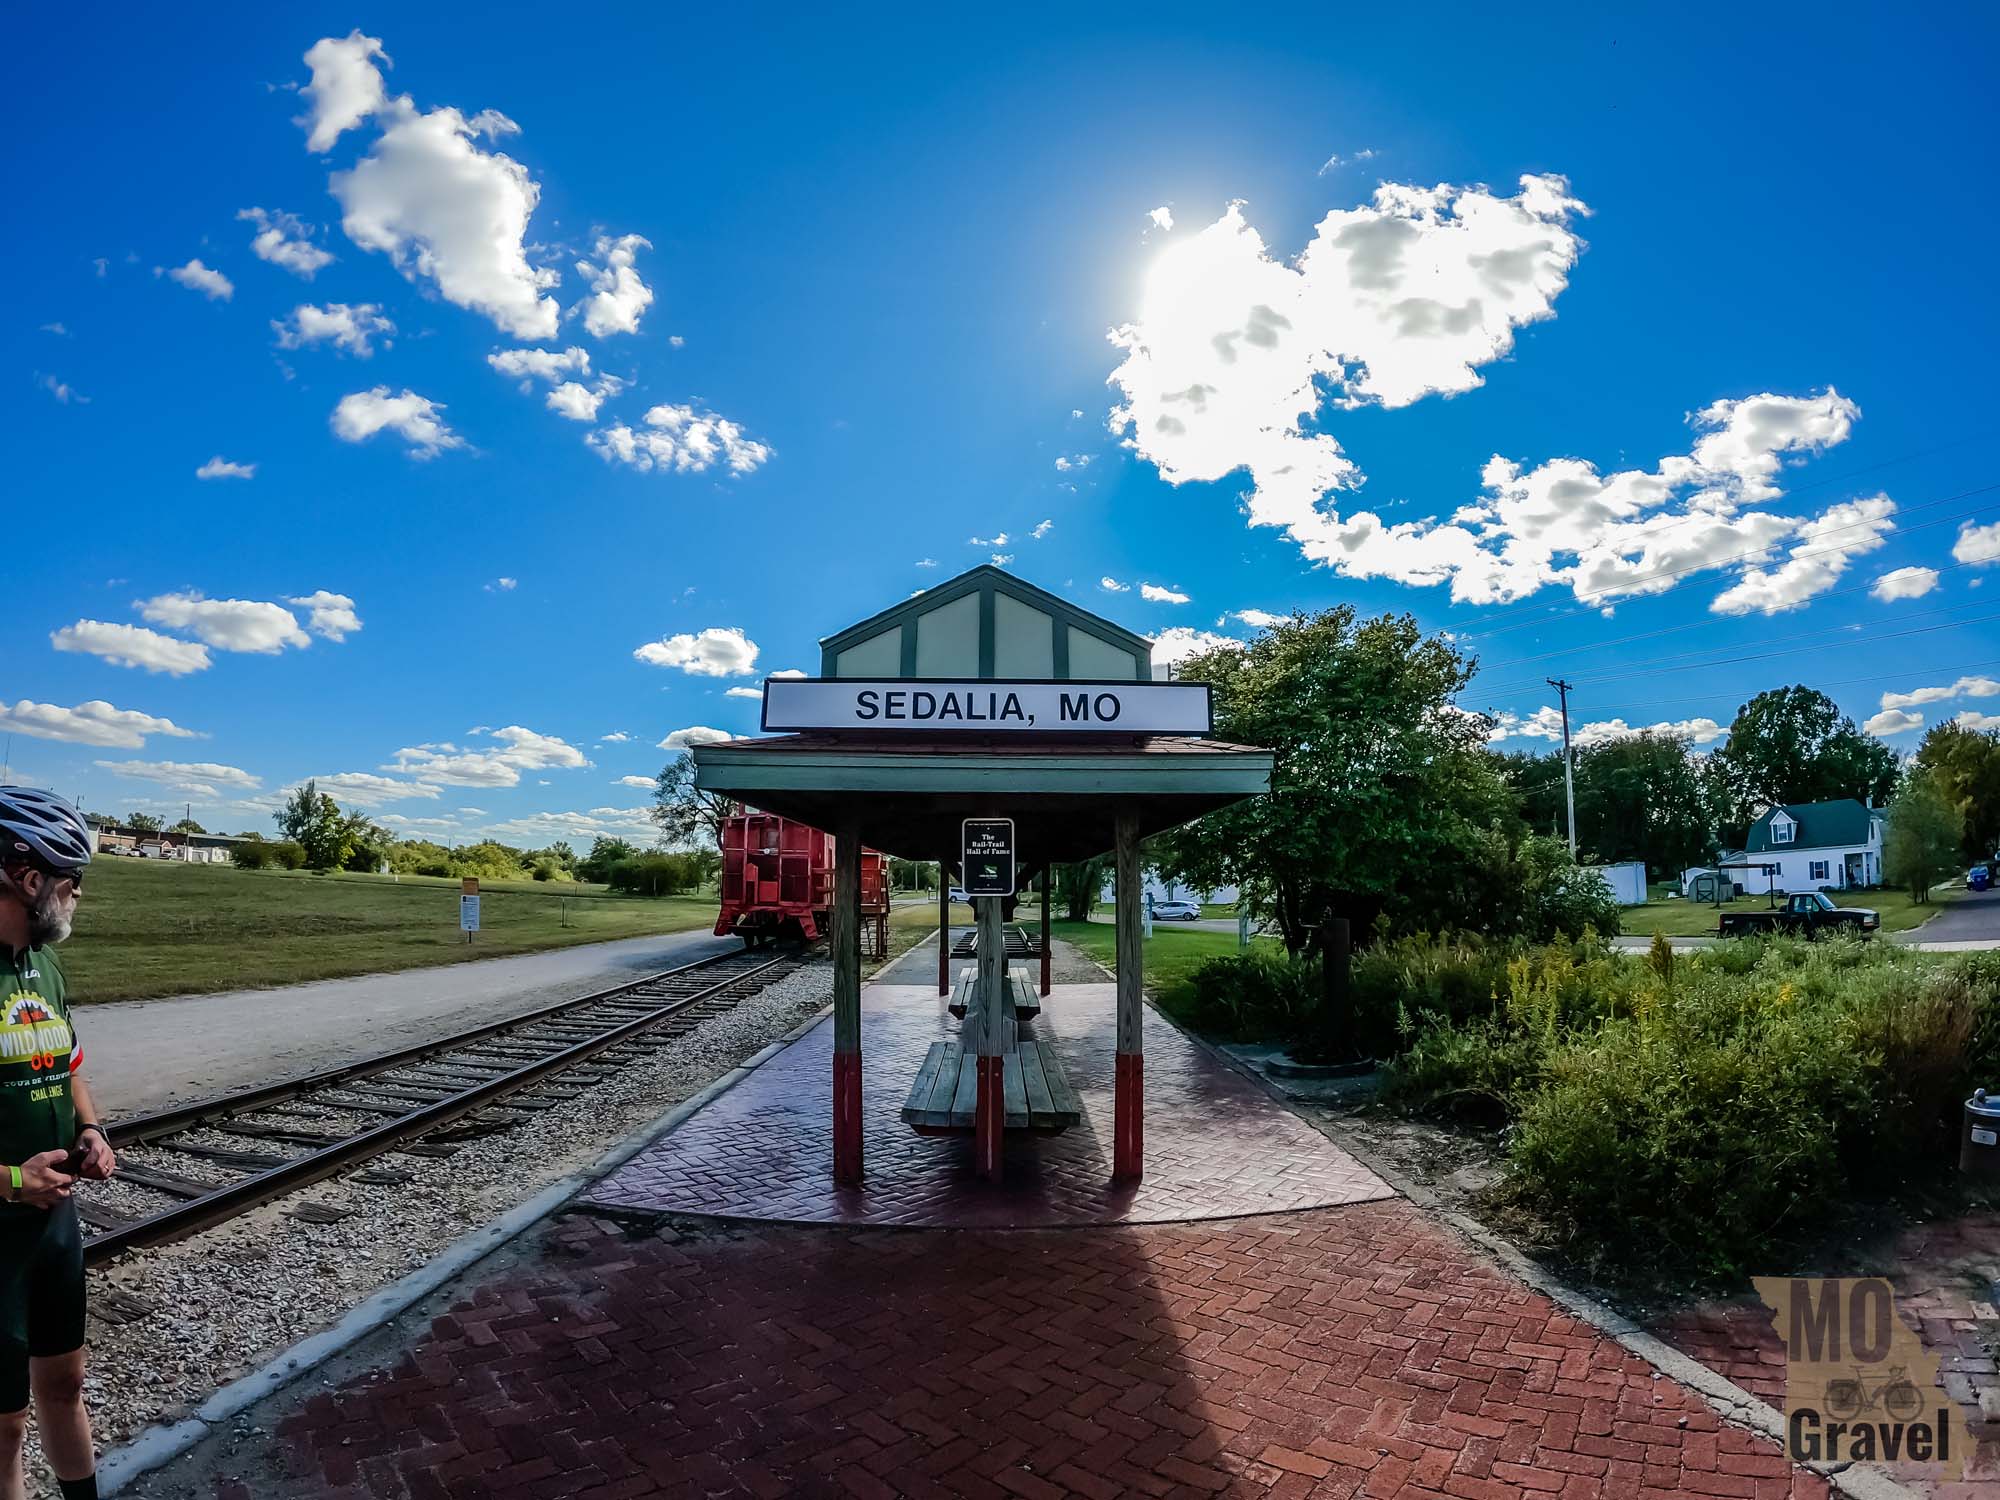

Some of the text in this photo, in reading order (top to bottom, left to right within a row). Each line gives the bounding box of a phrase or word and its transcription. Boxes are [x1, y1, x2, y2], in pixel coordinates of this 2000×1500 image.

[855, 690, 1121, 727] SEDALIA, MO
[30, 1084, 63, 1102] CHALENGE
